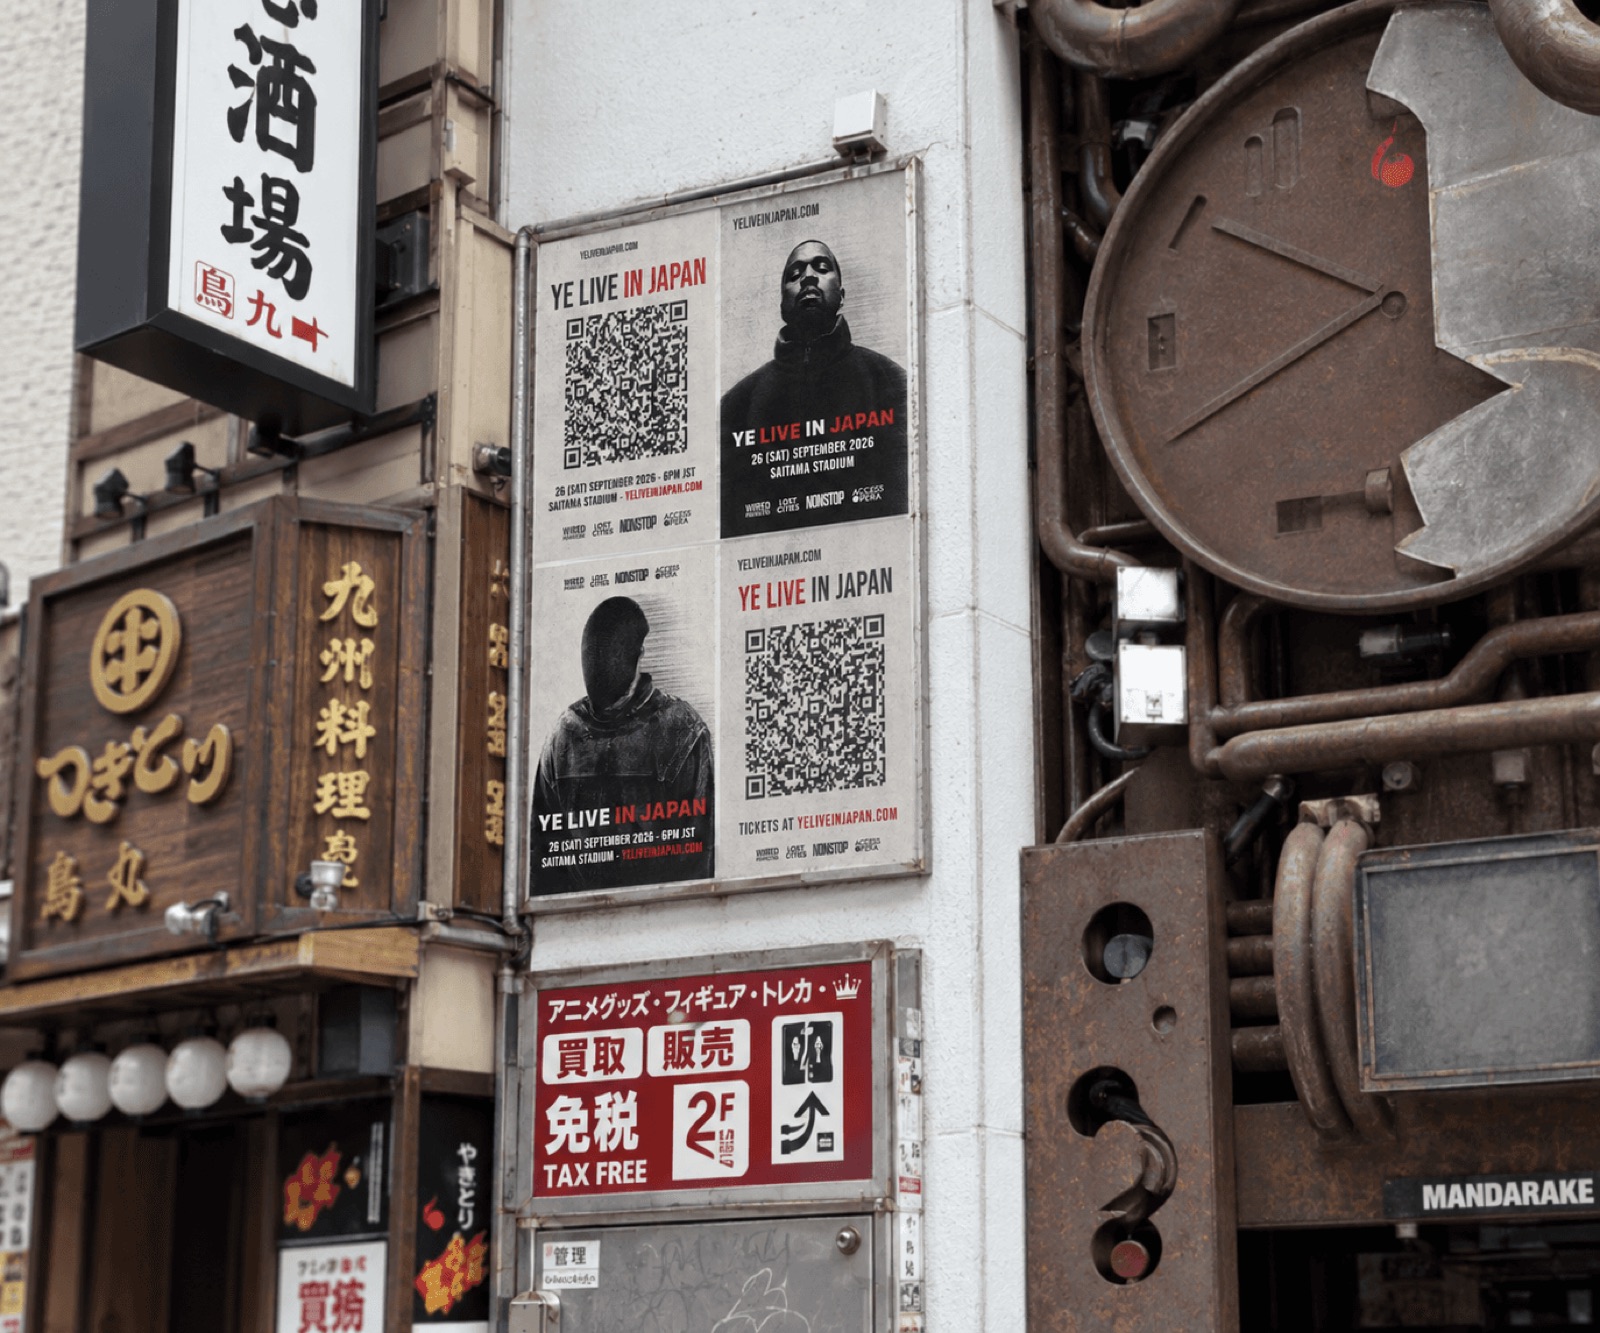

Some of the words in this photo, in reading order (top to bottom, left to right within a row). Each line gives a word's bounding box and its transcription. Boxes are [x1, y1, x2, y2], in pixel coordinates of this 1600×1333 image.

[733, 203, 820, 230] YELIVEINJAPAN.COM
[551, 281, 574, 311] YE
[579, 273, 618, 306] LIVE
[623, 269, 643, 298] IN
[648, 257, 706, 294] JAPAN
[732, 429, 756, 447] YE
[760, 423, 801, 444] LIVE
[805, 419, 826, 437] IN
[830, 408, 894, 433] JAPAN
[751, 453, 763, 465] 26
[766, 449, 790, 465] (SAT)
[793, 440, 846, 459] SEPTEMBER
[849, 436, 874, 450] 2026
[555, 486, 565, 497] 26
[589, 476, 634, 492] SEPTEMBER
[636, 473, 656, 485] 2026
[663, 469, 680, 481] 6PM
[682, 467, 696, 478] JST
[770, 464, 810, 479] SAITAMA
[813, 456, 855, 473] STADIUM
[583, 492, 617, 506] STADIUM
[625, 480, 703, 501] YELIVEINJAPAN.COM
[806, 491, 845, 510] NONSTOP
[619, 515, 657, 533] NONSTOP
[737, 549, 822, 571] YELIVEINJAPAN.COM
[615, 568, 650, 585] NONSTOP
[738, 584, 761, 611] YE
[767, 578, 806, 609] LIVE
[812, 575, 829, 603] IN
[836, 567, 893, 600] JAPAN
[538, 813, 563, 832] YE
[568, 808, 610, 829] LIVE
[615, 805, 636, 824] IN
[640, 797, 707, 822] JAPAN
[739, 819, 779, 836] TICKETS
[782, 817, 794, 831] AT
[797, 807, 898, 830] YELIVEINJAPAN.COM
[549, 841, 559, 853] 26
[584, 833, 631, 850] SEPTEMBER
[633, 831, 654, 844] 2026
[661, 828, 680, 841] 6PM
[681, 827, 696, 839] JST
[813, 841, 849, 857] NONSTOP
[578, 850, 614, 865] STADIUM
[557, 1036, 626, 1079] 買取
[663, 1027, 734, 1071] 販売
[544, 1090, 639, 1156] 免税
[543, 1163, 590, 1189] TAX
[596, 1159, 647, 1185] FREE
[1422, 1178, 1595, 1211] MANDARAKE
